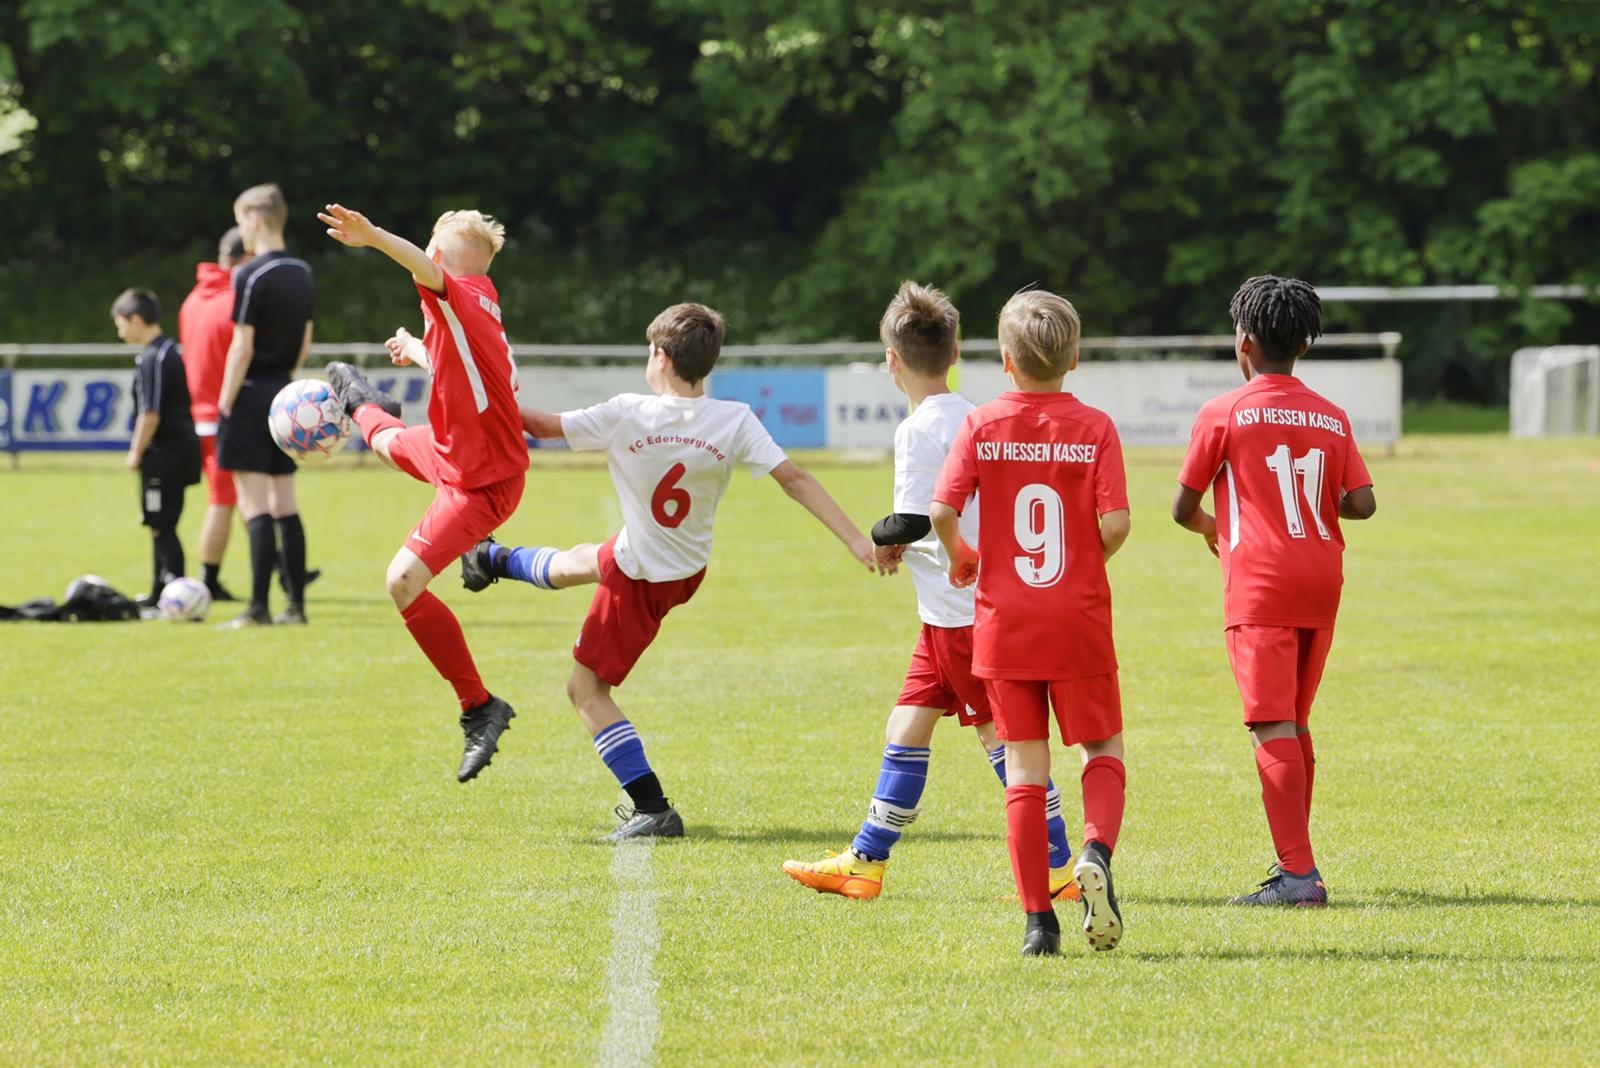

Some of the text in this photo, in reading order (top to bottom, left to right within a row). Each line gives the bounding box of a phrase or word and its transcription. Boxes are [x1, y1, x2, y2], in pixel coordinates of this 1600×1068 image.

[1235, 408, 1260, 427] KSV
[1262, 407, 1307, 427] HESSEN
[1308, 411, 1346, 437] KASSEL
[628, 435, 726, 461] FC Ederbergland
[976, 441, 1096, 463] KSV HESSEN KASSEL
[651, 462, 691, 529] 6
[1265, 444, 1331, 540] 11
[1014, 483, 1066, 588] 9
